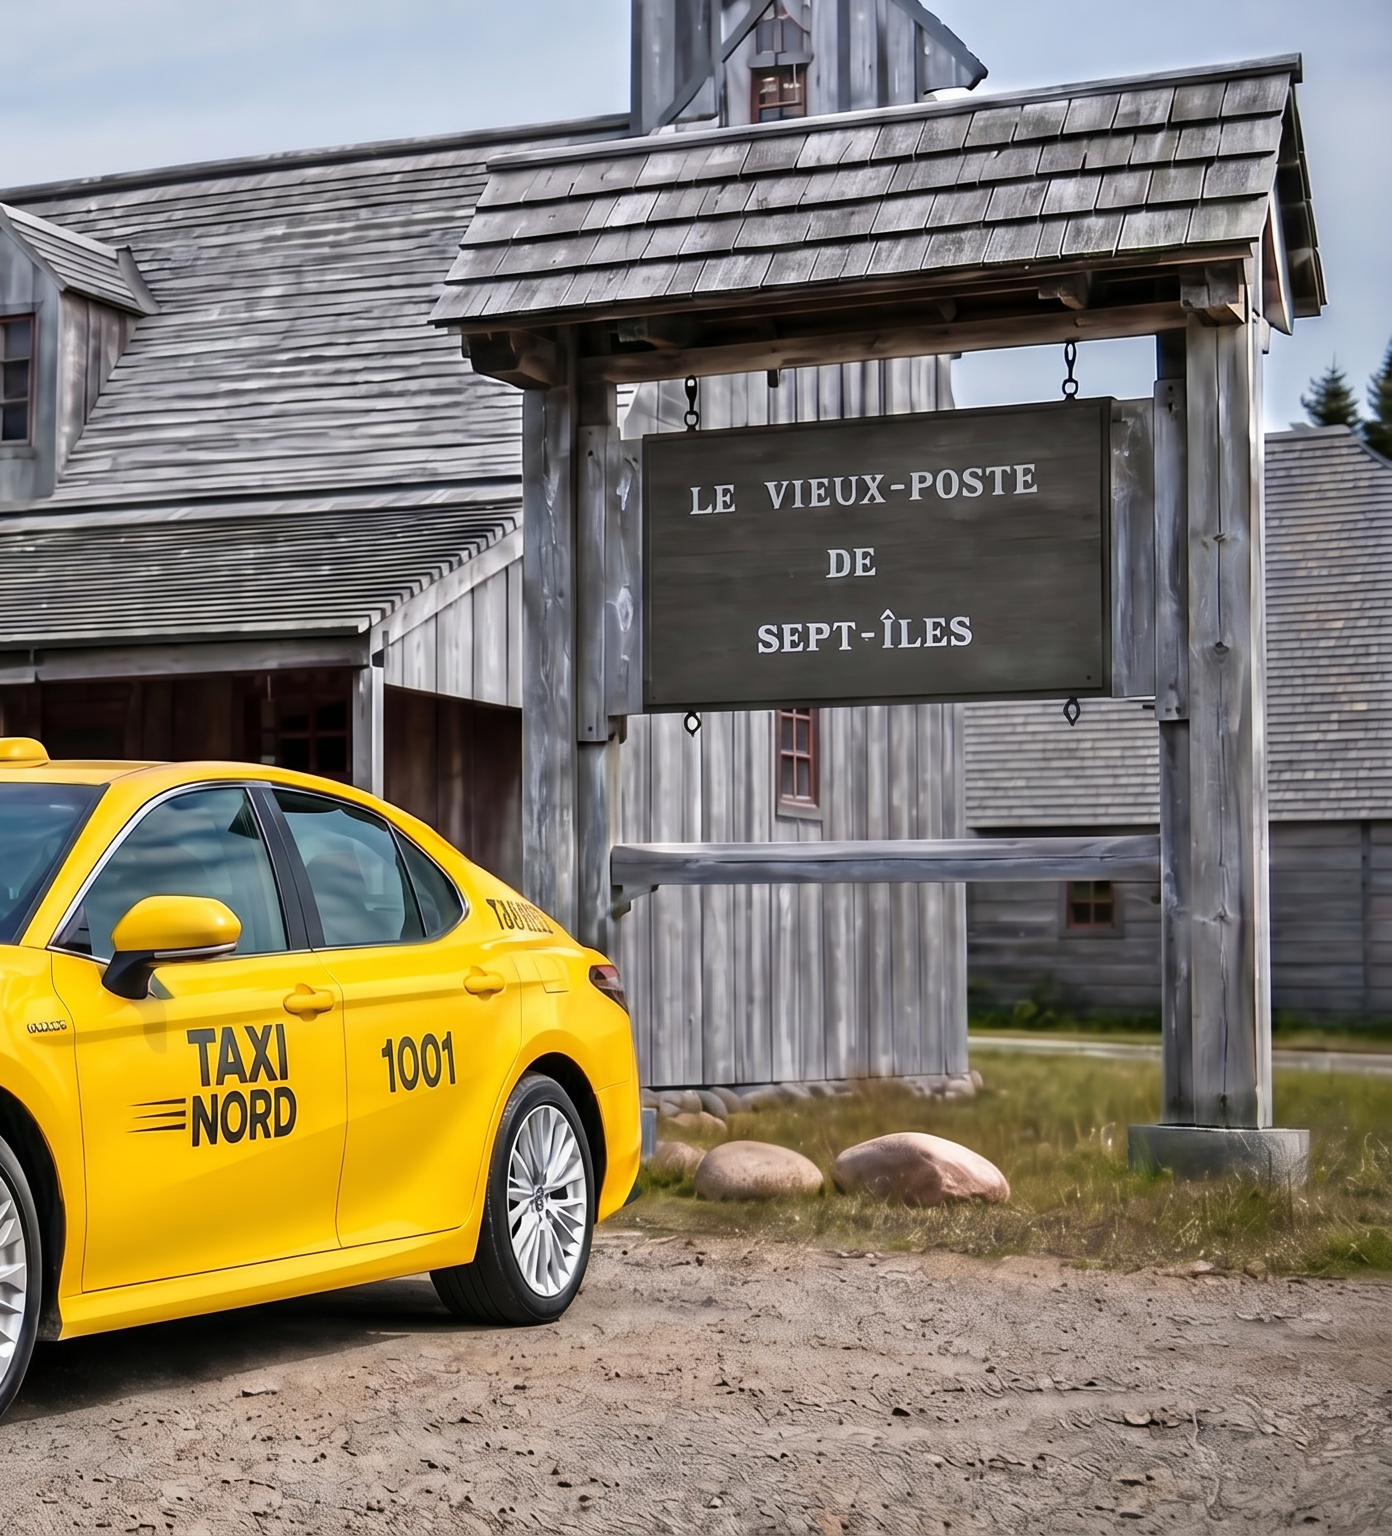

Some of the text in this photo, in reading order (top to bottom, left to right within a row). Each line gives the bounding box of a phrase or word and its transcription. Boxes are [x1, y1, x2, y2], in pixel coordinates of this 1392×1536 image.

[690, 464, 1038, 515] LE VIEUX-POSTE
[826, 547, 876, 578] DE
[758, 608, 973, 654] SEPT-ÎLES
[187, 1024, 289, 1087] TAXI
[381, 1031, 456, 1093] 1001
[192, 1086, 297, 1148] NORD
